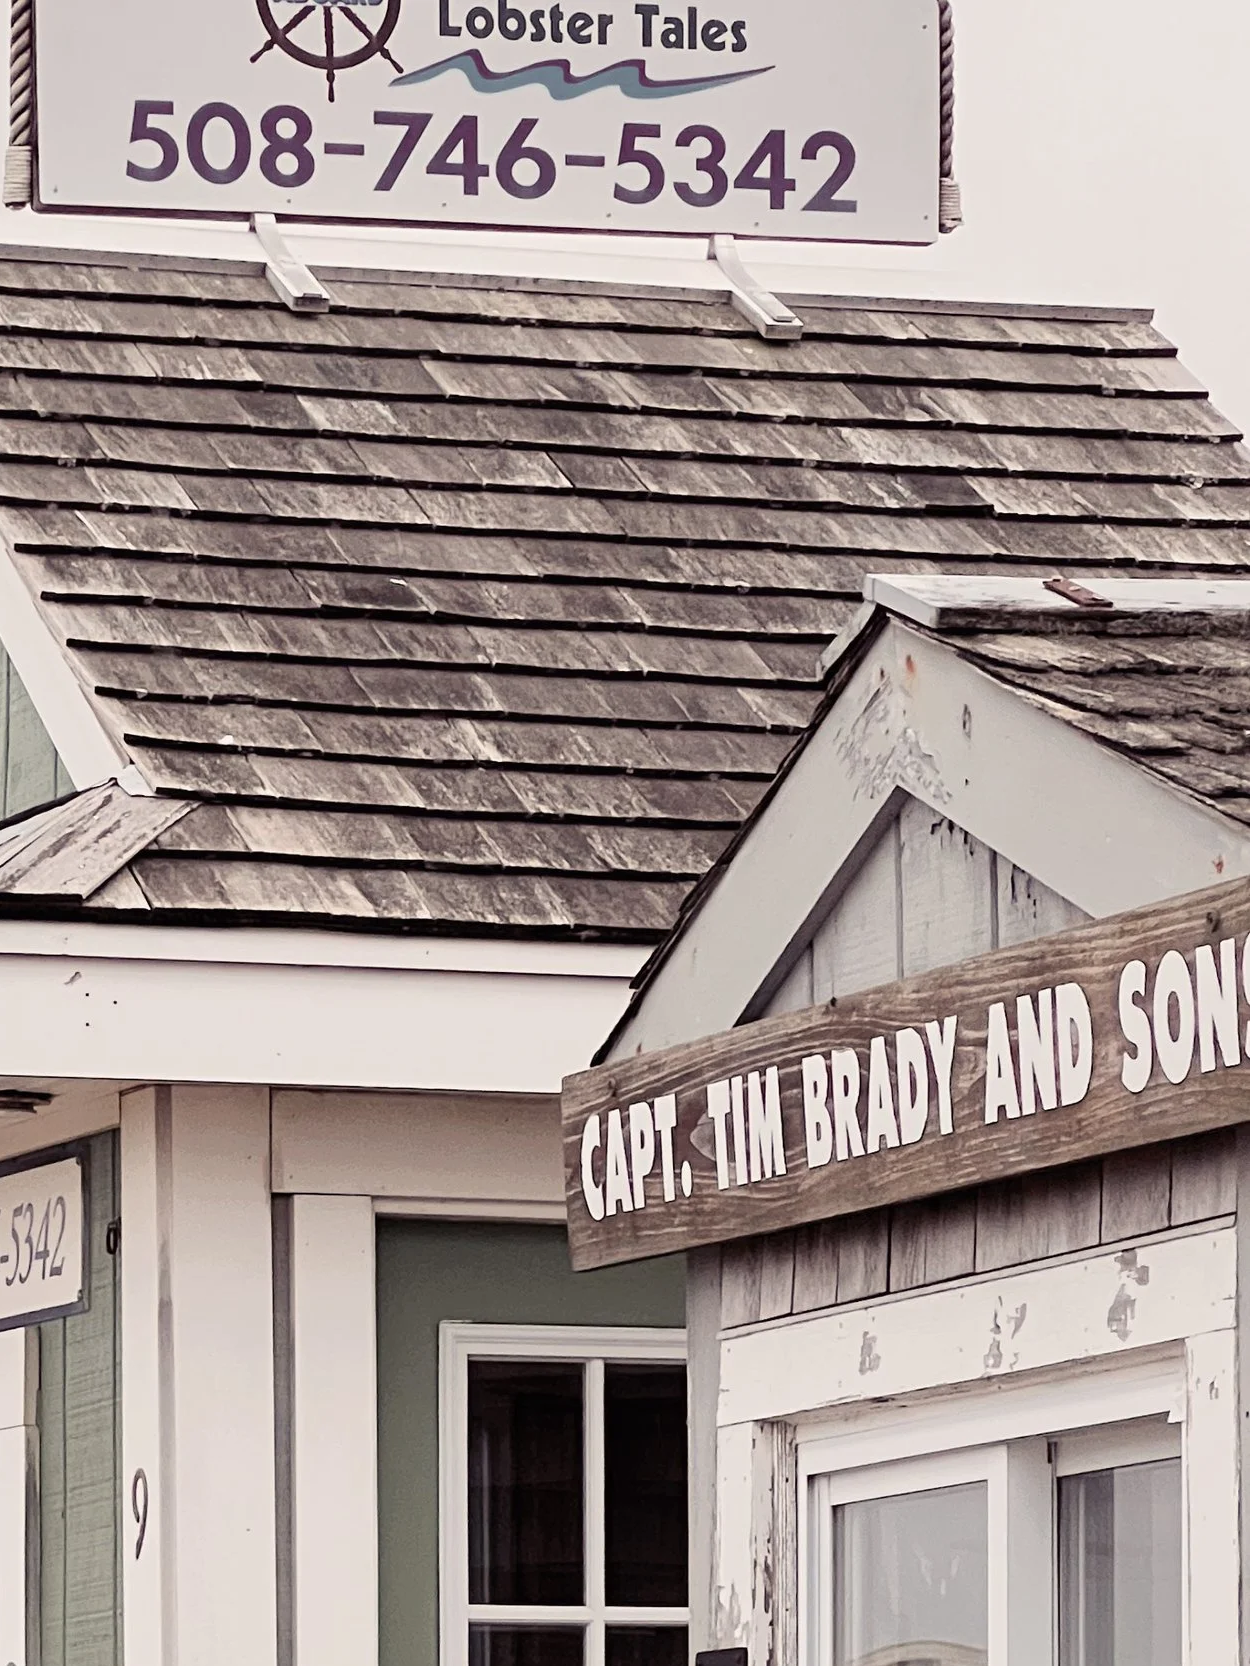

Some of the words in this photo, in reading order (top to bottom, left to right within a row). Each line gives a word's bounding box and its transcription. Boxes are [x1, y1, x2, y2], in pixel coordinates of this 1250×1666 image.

[438, 0, 614, 46] Lobster
[635, 3, 748, 53] Tales
[125, 100, 859, 213] 508-746-5342
[579, 1094, 692, 1222] CAPT.
[706, 1065, 787, 1191] TIM
[801, 1015, 958, 1168] BRADY
[984, 981, 1093, 1125] AND
[1118, 932, 1250, 1094] SON
[132, 1467, 149, 1560] 9
